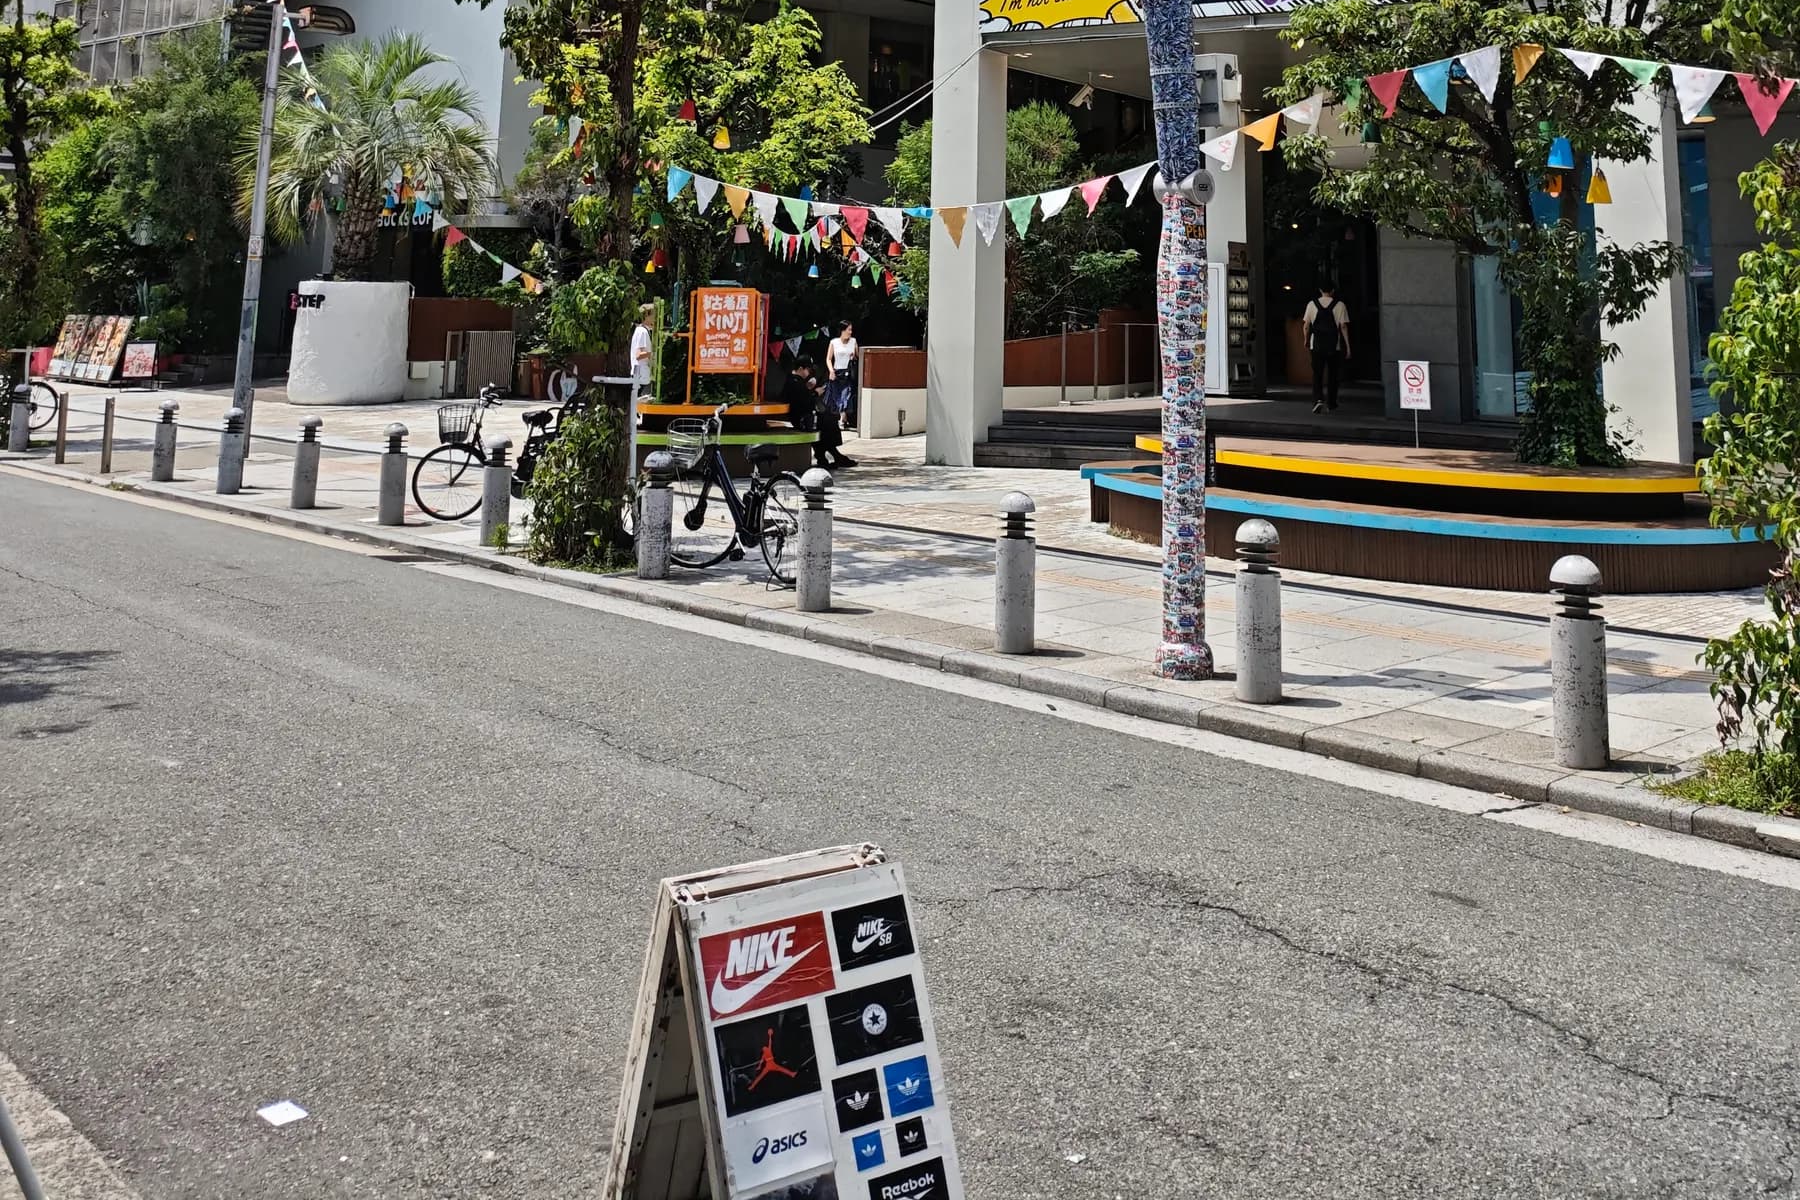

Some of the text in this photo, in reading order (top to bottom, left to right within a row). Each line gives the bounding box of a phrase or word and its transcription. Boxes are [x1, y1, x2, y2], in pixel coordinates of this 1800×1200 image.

[857, 917, 885, 938] NIKE
[878, 932, 893, 946] SB
[725, 925, 797, 979] NIKE
[770, 1129, 808, 1154] asics
[881, 1172, 935, 1200] Reebok
